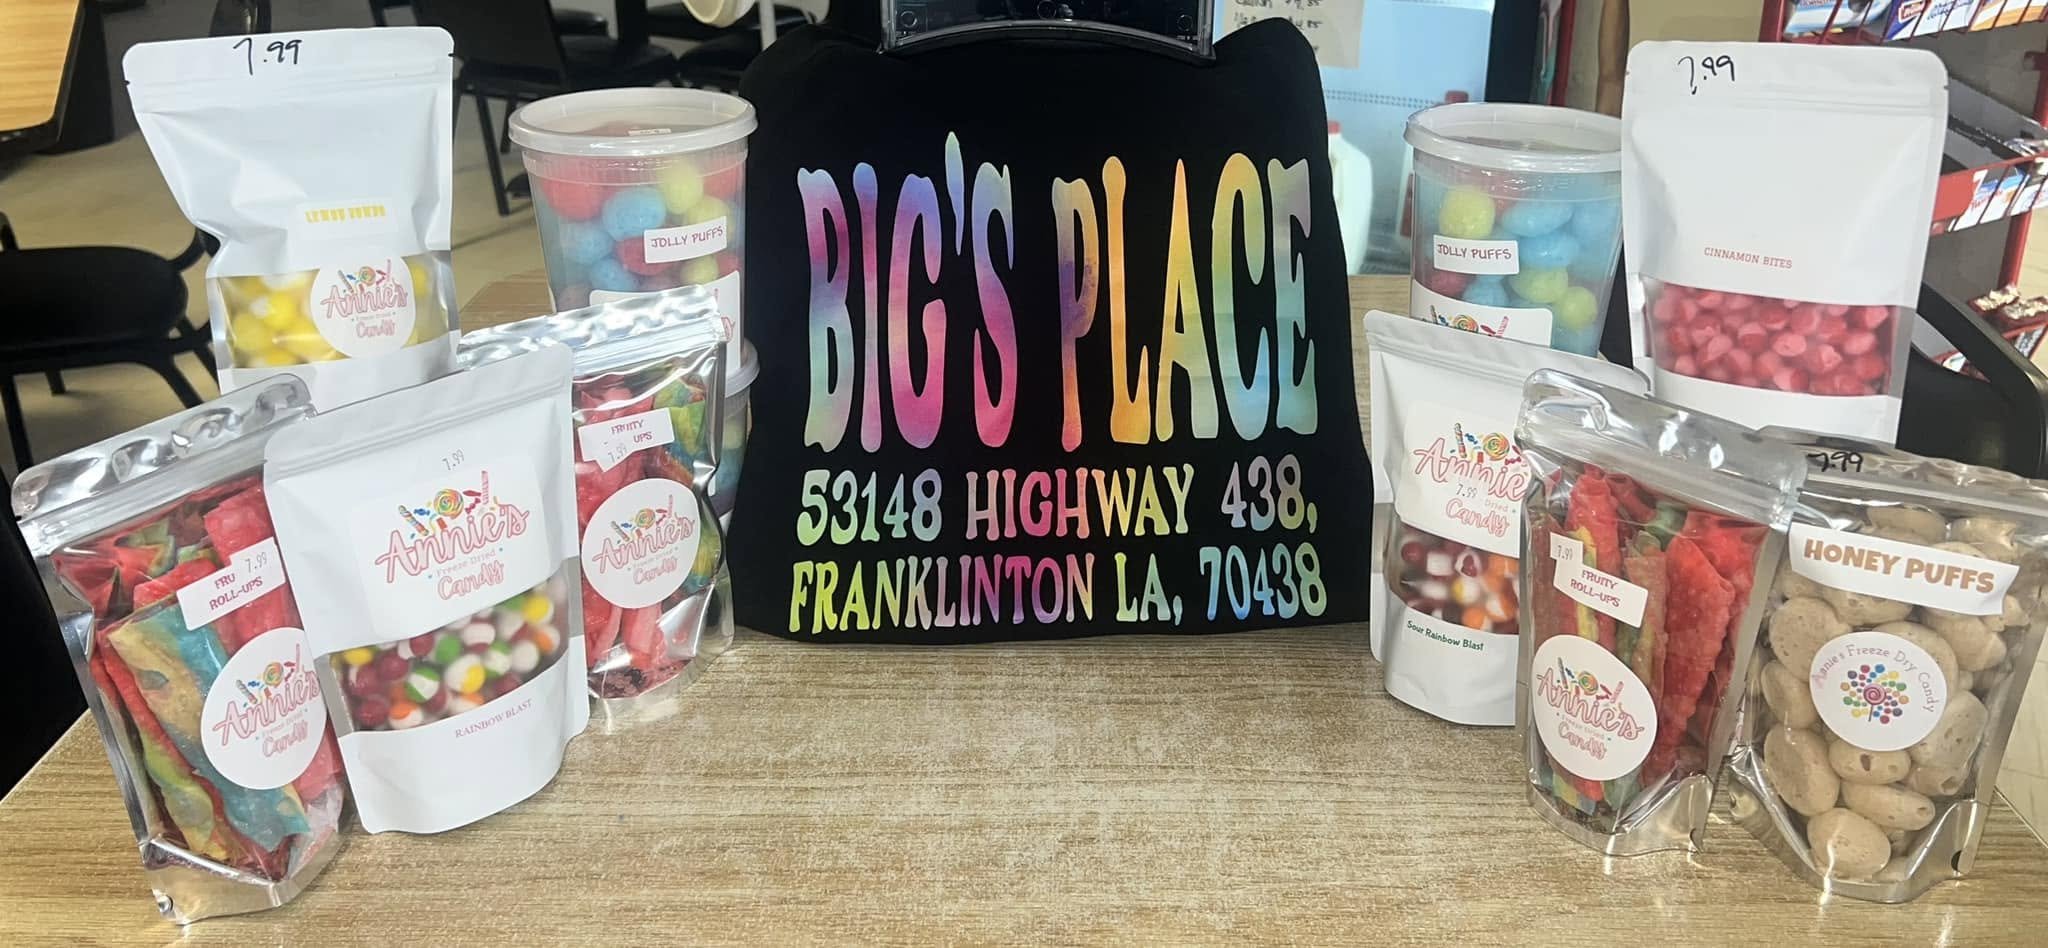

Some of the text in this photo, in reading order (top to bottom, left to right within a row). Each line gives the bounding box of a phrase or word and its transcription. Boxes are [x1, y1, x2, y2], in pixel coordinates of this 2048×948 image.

[650, 226, 724, 249] JOLLY PUFFS
[1436, 243, 1513, 261] JOLLY PUFFS
[1703, 246, 1793, 270] CINNAMON BITES
[797, 131, 1318, 453] BIG'S PLACE
[610, 419, 645, 436] FRUITY
[441, 449, 465, 472] 7.99
[1413, 437, 1528, 502] Annie
[796, 454, 1319, 546] 53148 HIGHWAY 438,
[1446, 498, 1510, 537] Candy
[375, 496, 530, 584] Annie's
[592, 513, 696, 575] Annie's
[214, 573, 236, 590] FRU
[244, 552, 267, 573] 7.99
[437, 559, 505, 600] Candy
[1582, 569, 1619, 590] FRUITY
[1803, 538, 1996, 594] HONEY PUFFS
[209, 576, 263, 610] ROLL-UPS
[788, 542, 1329, 635] FRANKLINTON LA, 70438
[1570, 578, 1621, 608] ROLL-UPS
[1407, 620, 1484, 651] Sour Rainbow Blast
[1846, 643, 1890, 660] Freeze
[1894, 649, 1918, 673] Dry
[1917, 671, 1939, 714] Candy
[212, 669, 321, 747] Annie's
[454, 698, 534, 739] RAINBOW BLAST
[1536, 667, 1644, 742] Annie's
